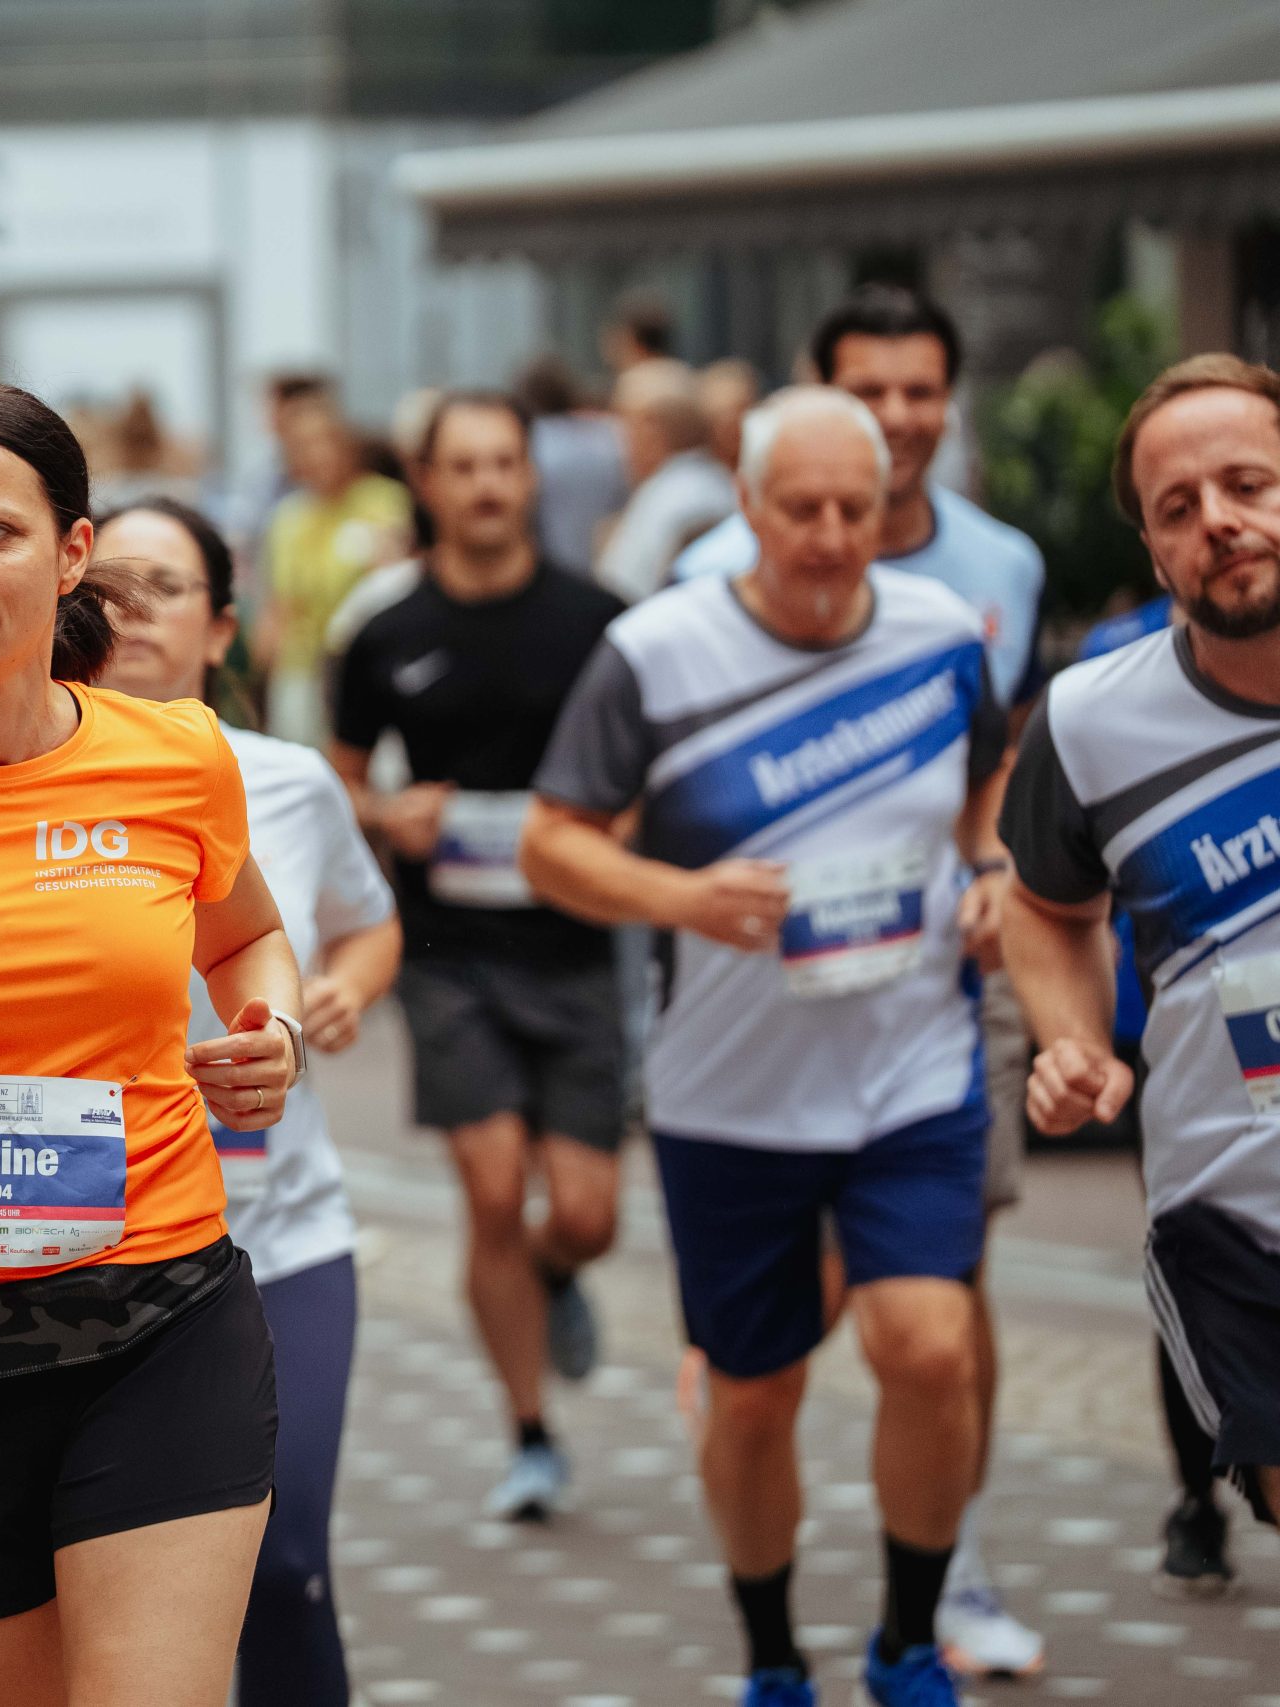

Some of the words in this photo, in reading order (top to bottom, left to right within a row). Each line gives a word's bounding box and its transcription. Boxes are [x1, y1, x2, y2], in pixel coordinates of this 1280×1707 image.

[35, 820, 129, 861] IDG
[35, 866, 91, 878] INSTITUT
[93, 863, 116, 876] FÜR
[119, 864, 162, 879] DIGITALE
[34, 877, 157, 892] GESUNDHEITSDATEN
[7, 1209, 21, 1217] UHR
